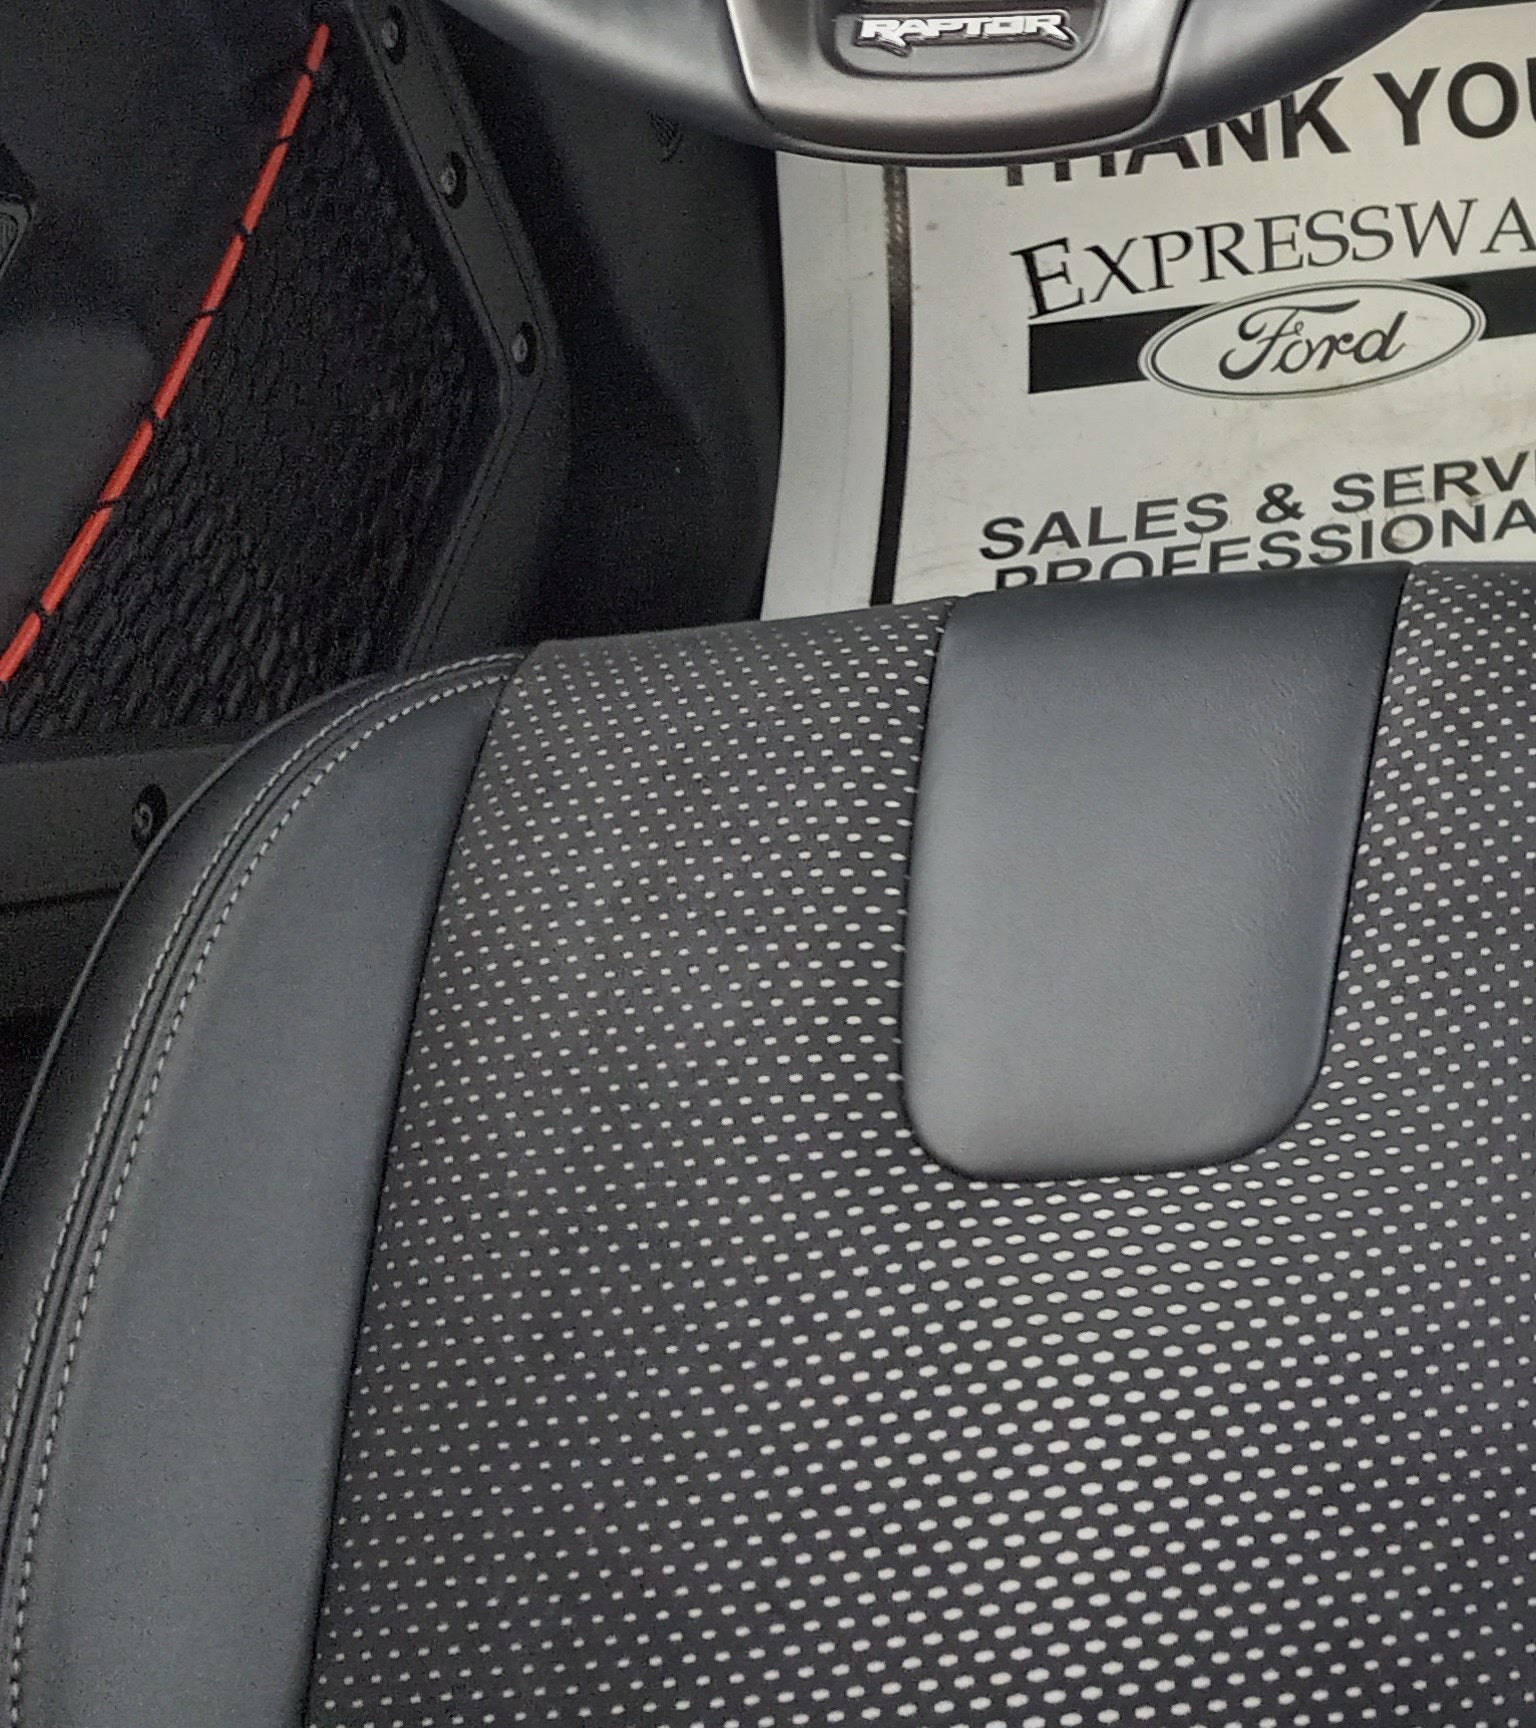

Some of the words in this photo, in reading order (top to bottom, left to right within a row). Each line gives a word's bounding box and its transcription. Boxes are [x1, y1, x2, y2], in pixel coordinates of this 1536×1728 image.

[858, 14, 1072, 48] RAPTOR
[1218, 297, 1409, 381] Ford
[978, 491, 1230, 562] SALES
[1256, 482, 1306, 524] &
